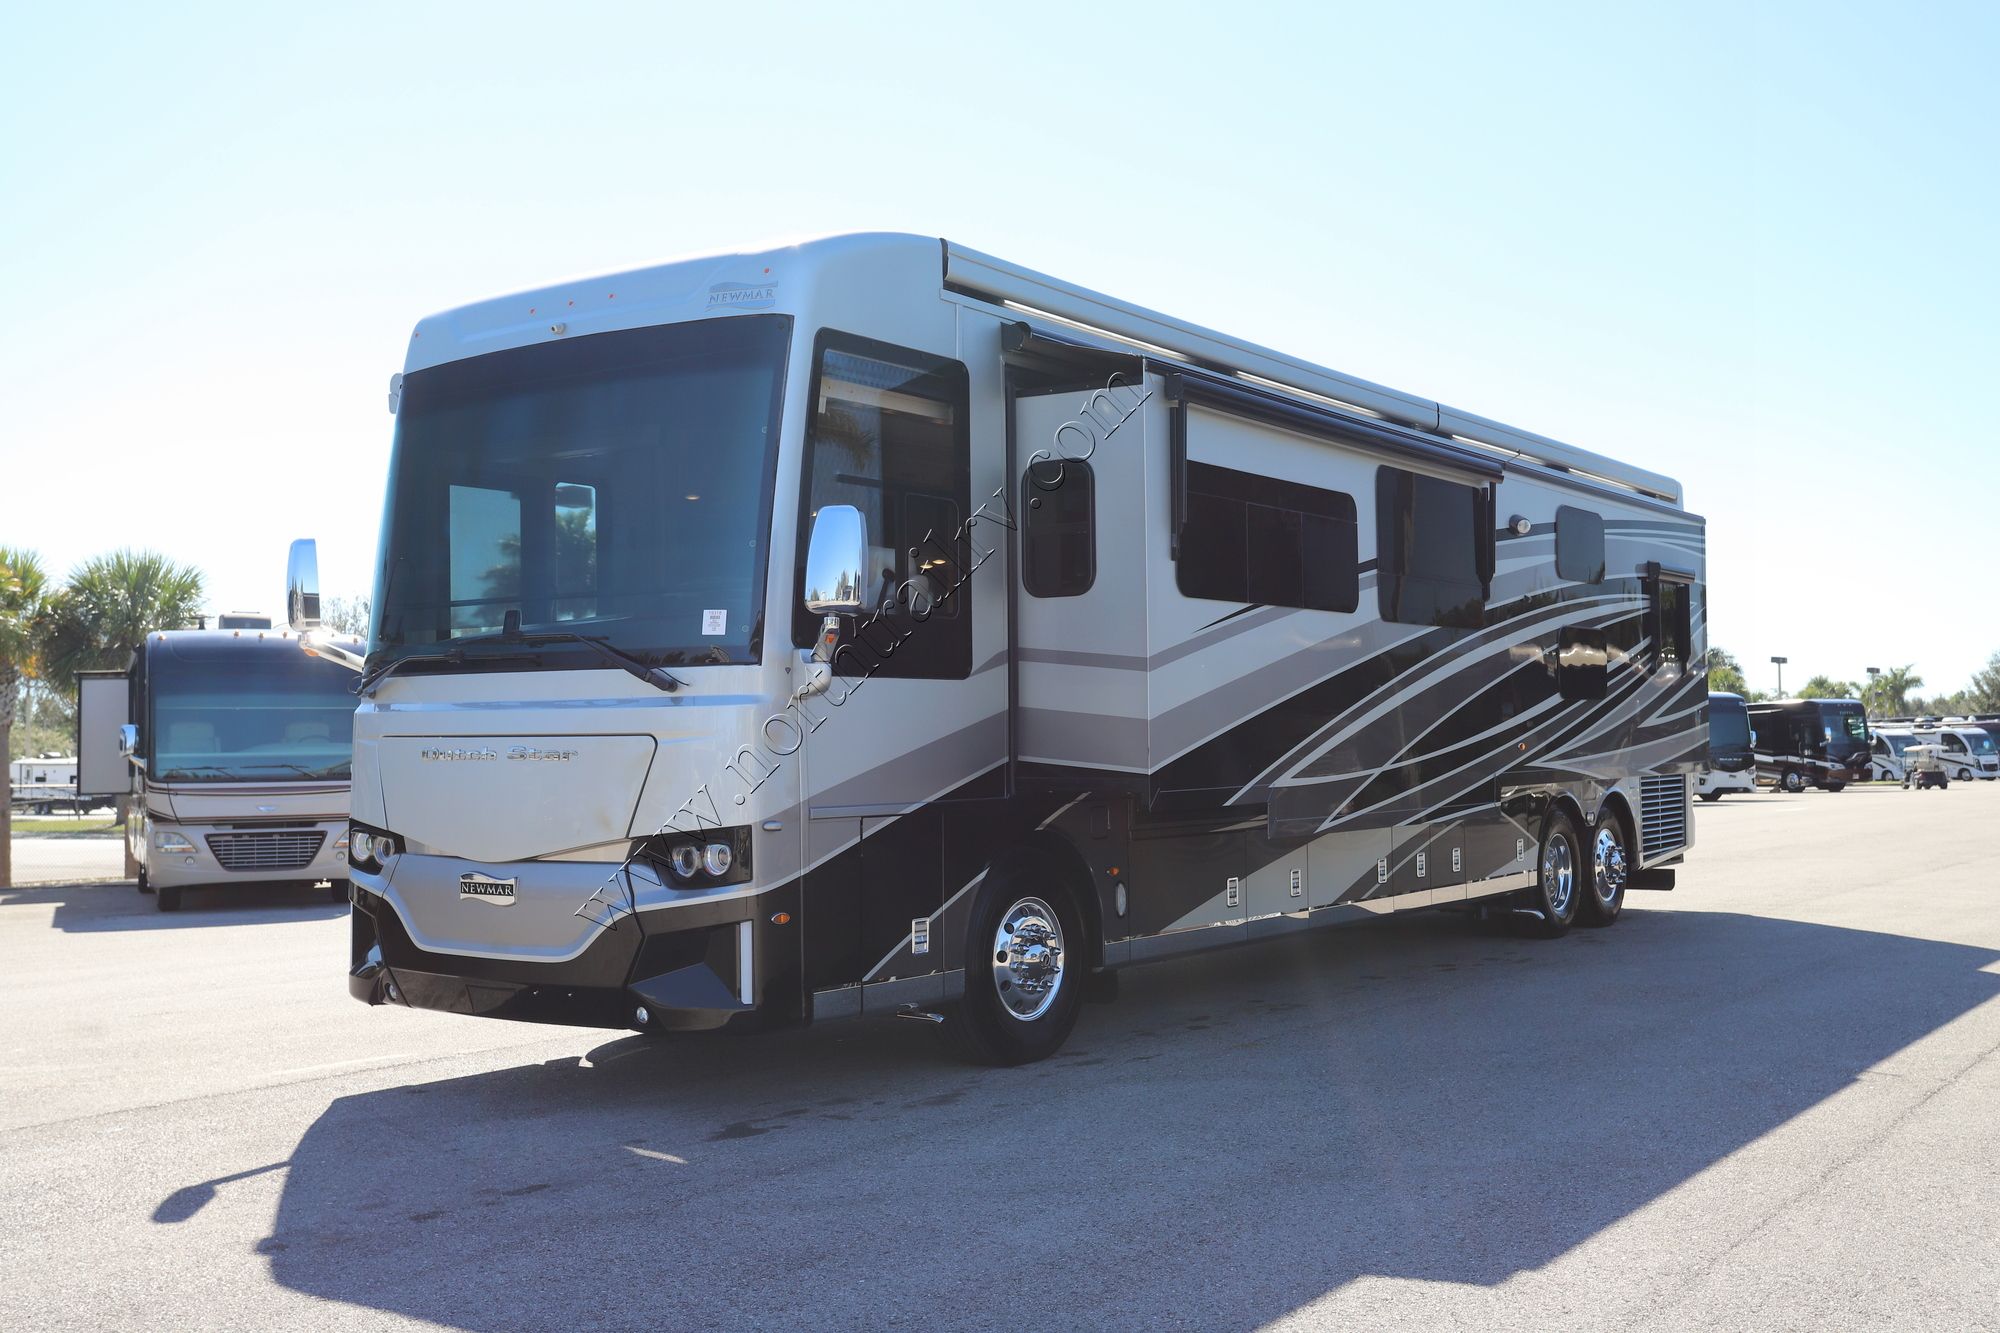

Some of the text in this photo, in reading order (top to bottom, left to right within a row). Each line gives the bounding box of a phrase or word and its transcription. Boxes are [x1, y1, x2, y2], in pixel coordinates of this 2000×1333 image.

[708, 288, 774, 304] NEWMAR
[421, 745, 574, 761] Dutch Star
[461, 883, 513, 896] NEWMAR
